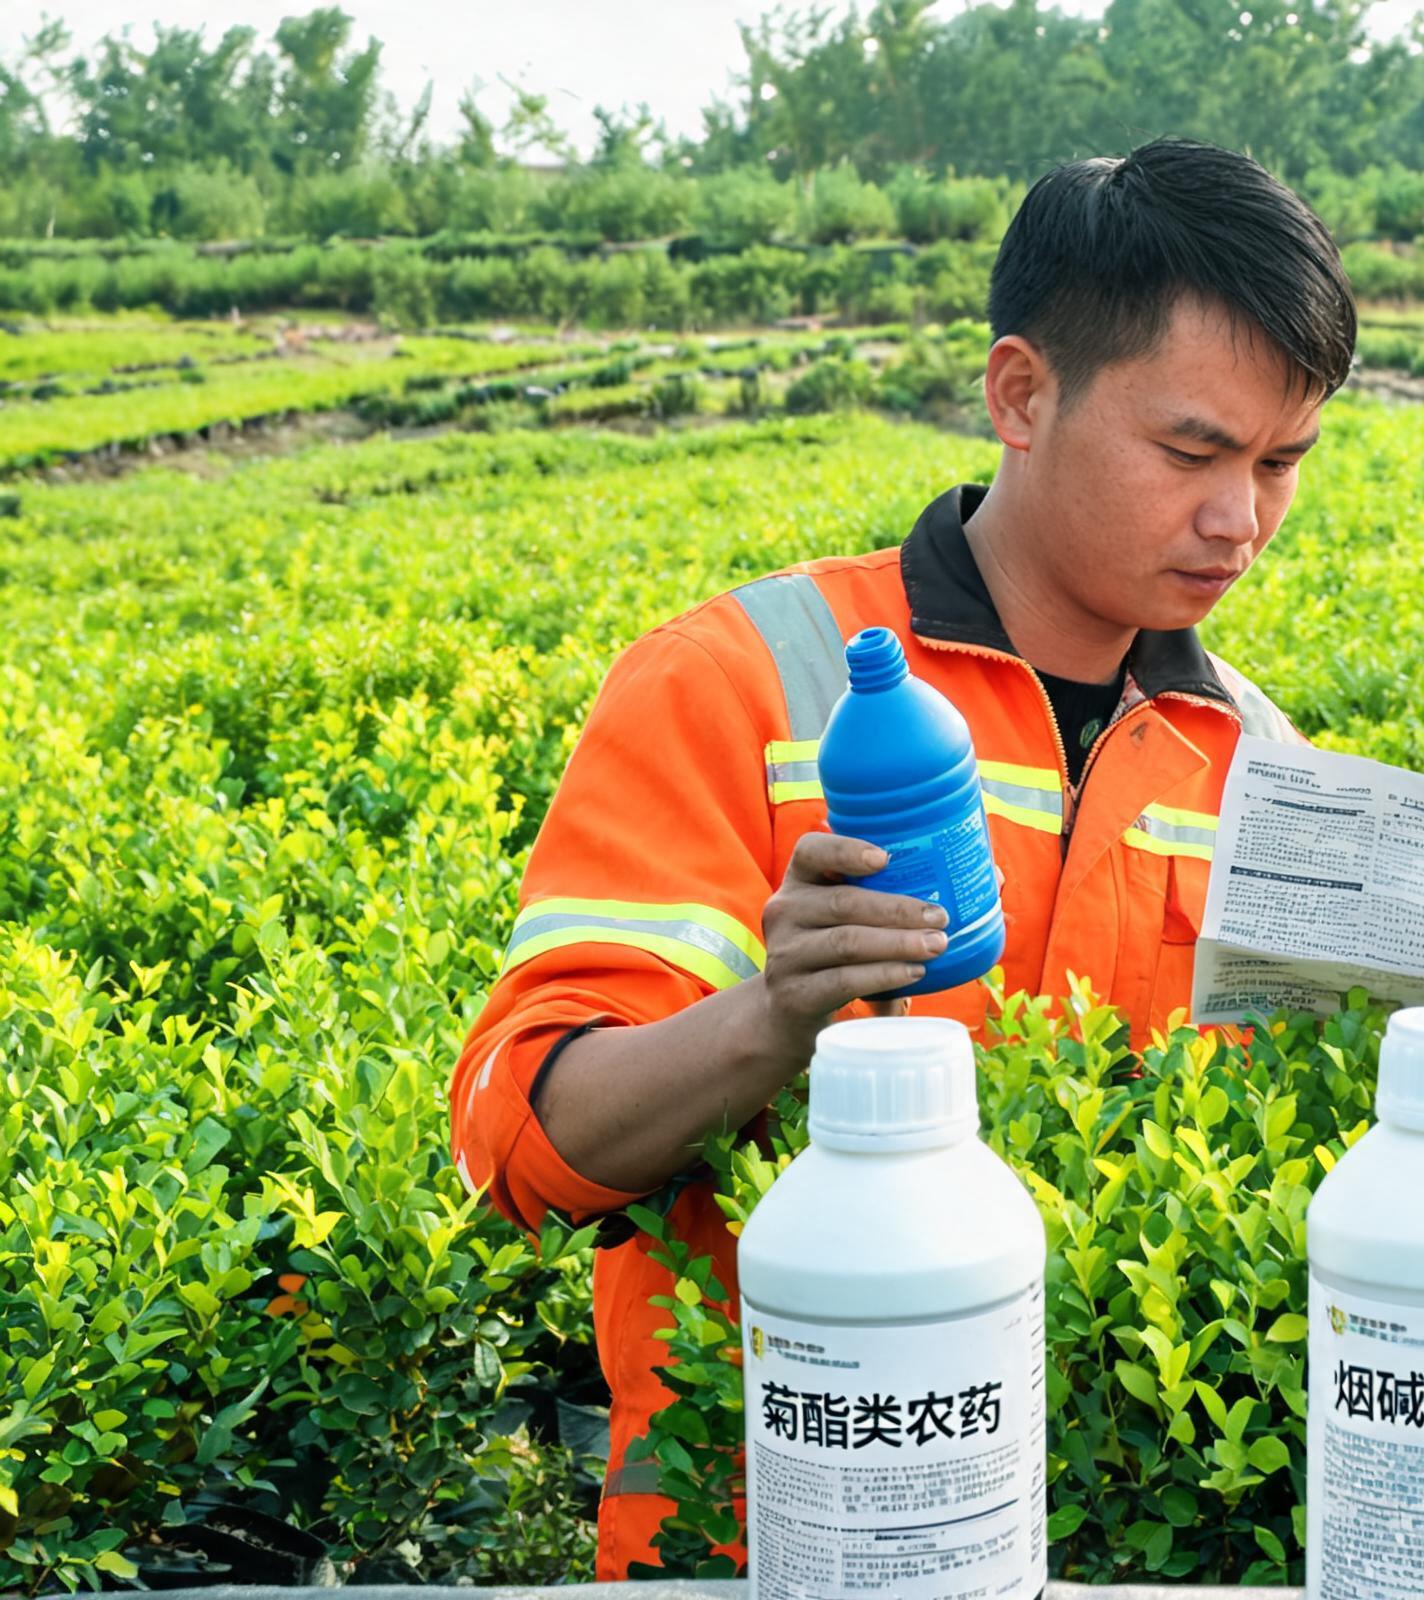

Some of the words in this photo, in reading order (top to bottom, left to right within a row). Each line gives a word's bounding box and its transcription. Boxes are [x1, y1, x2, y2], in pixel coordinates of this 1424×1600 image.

[761, 1381, 1002, 1449] 菊酯类农药
